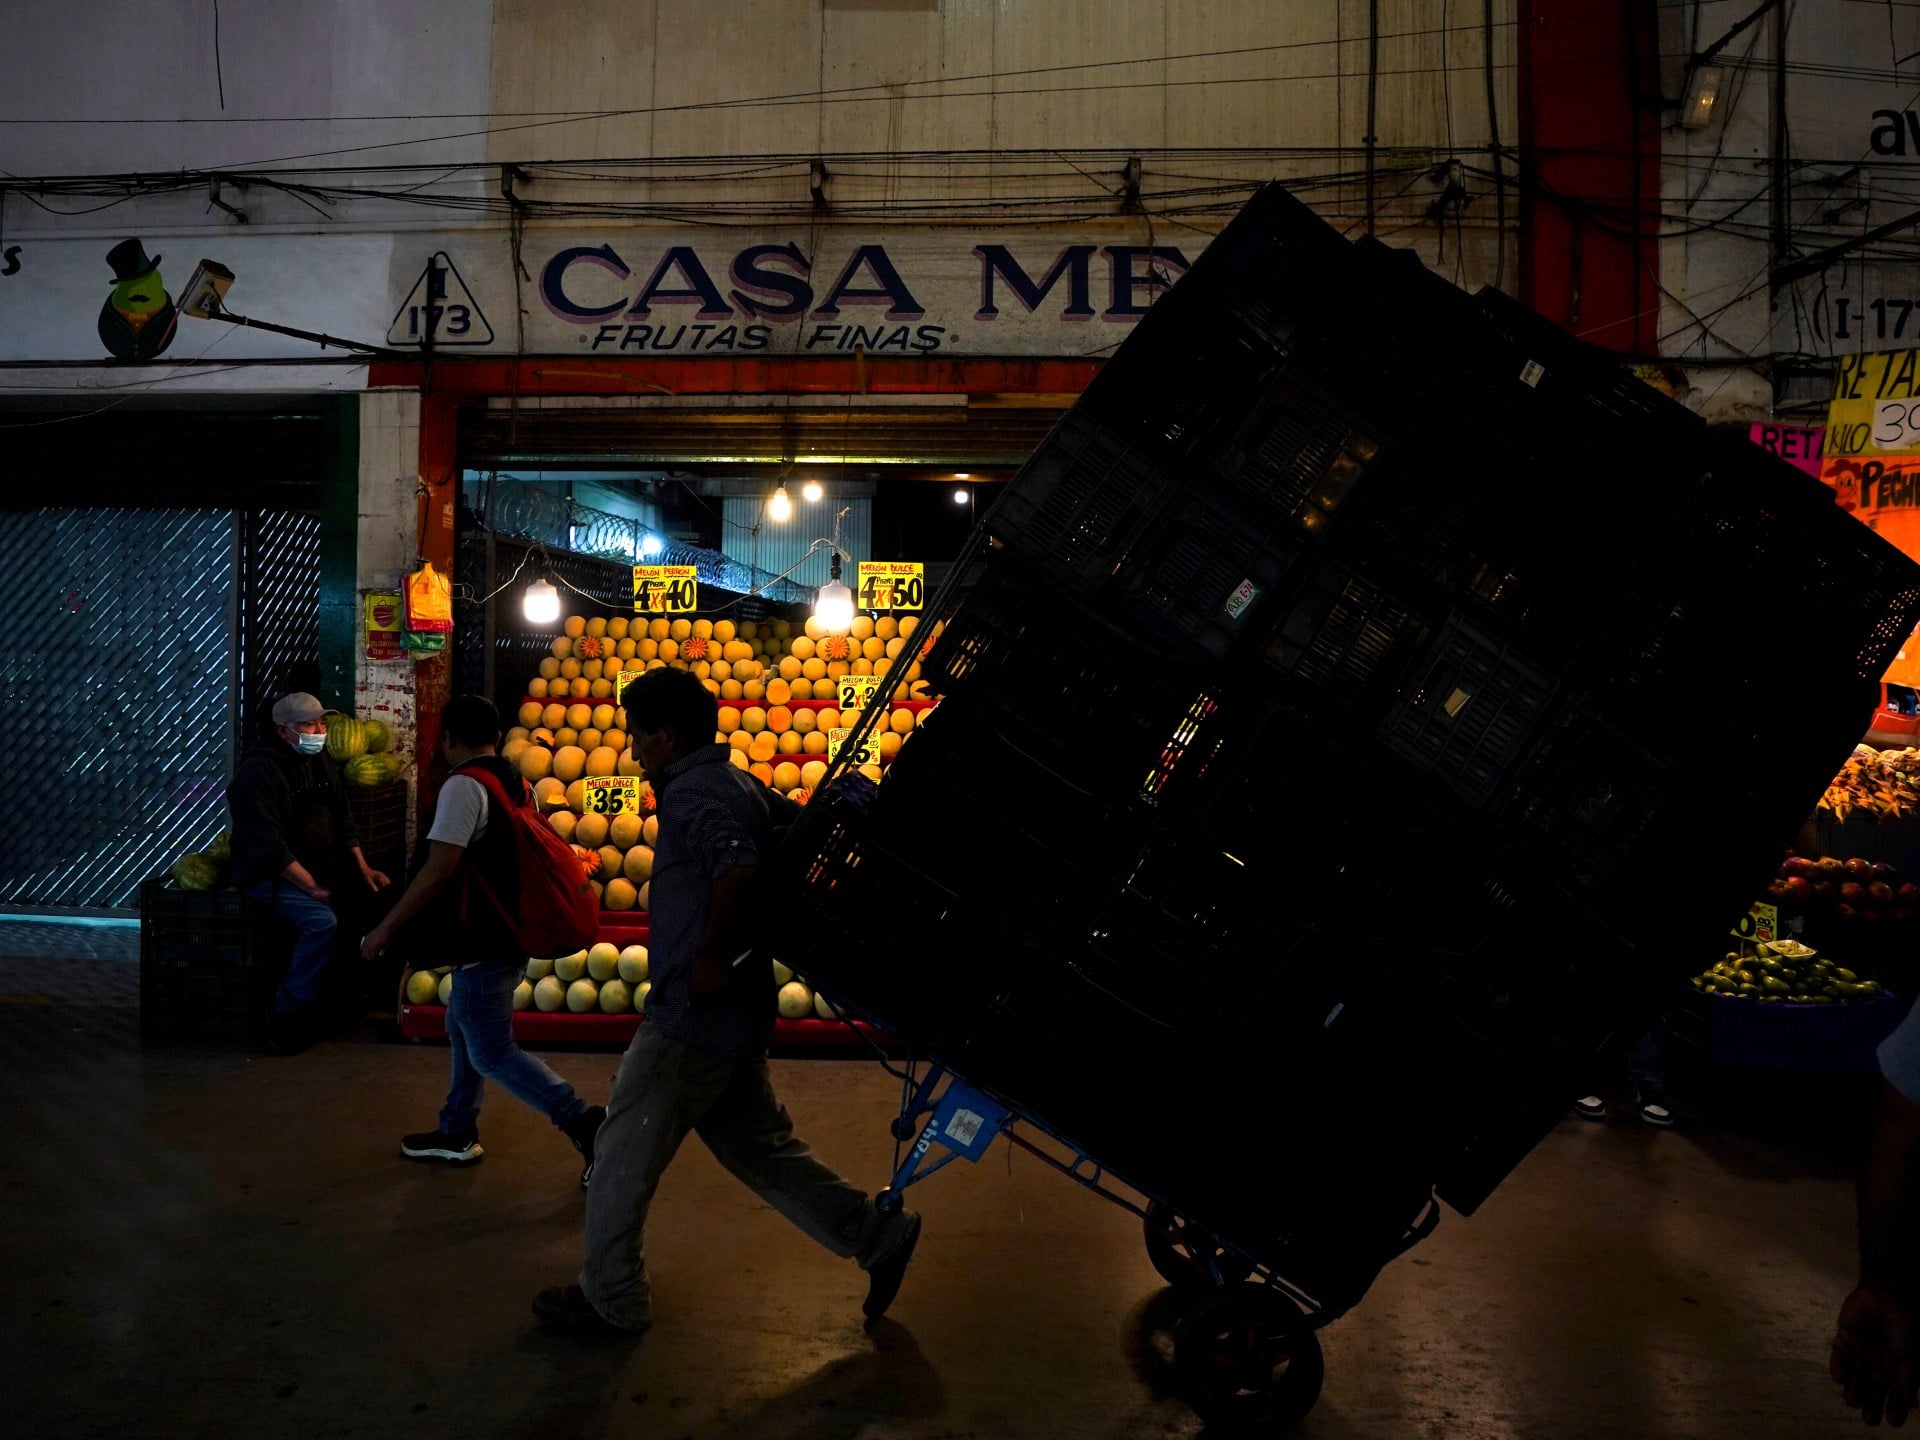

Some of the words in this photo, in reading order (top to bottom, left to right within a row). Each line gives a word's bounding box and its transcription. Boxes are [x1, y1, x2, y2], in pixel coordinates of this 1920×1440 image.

[540, 242, 925, 322] CASA
[408, 304, 471, 338] 173
[592, 324, 773, 351] FRUTAS
[806, 324, 946, 351] FINAS
[1813, 288, 1920, 343] (I-17
[1833, 347, 1920, 399] RETA
[1860, 460, 1920, 509] PECH
[593, 787, 624, 814] 35
